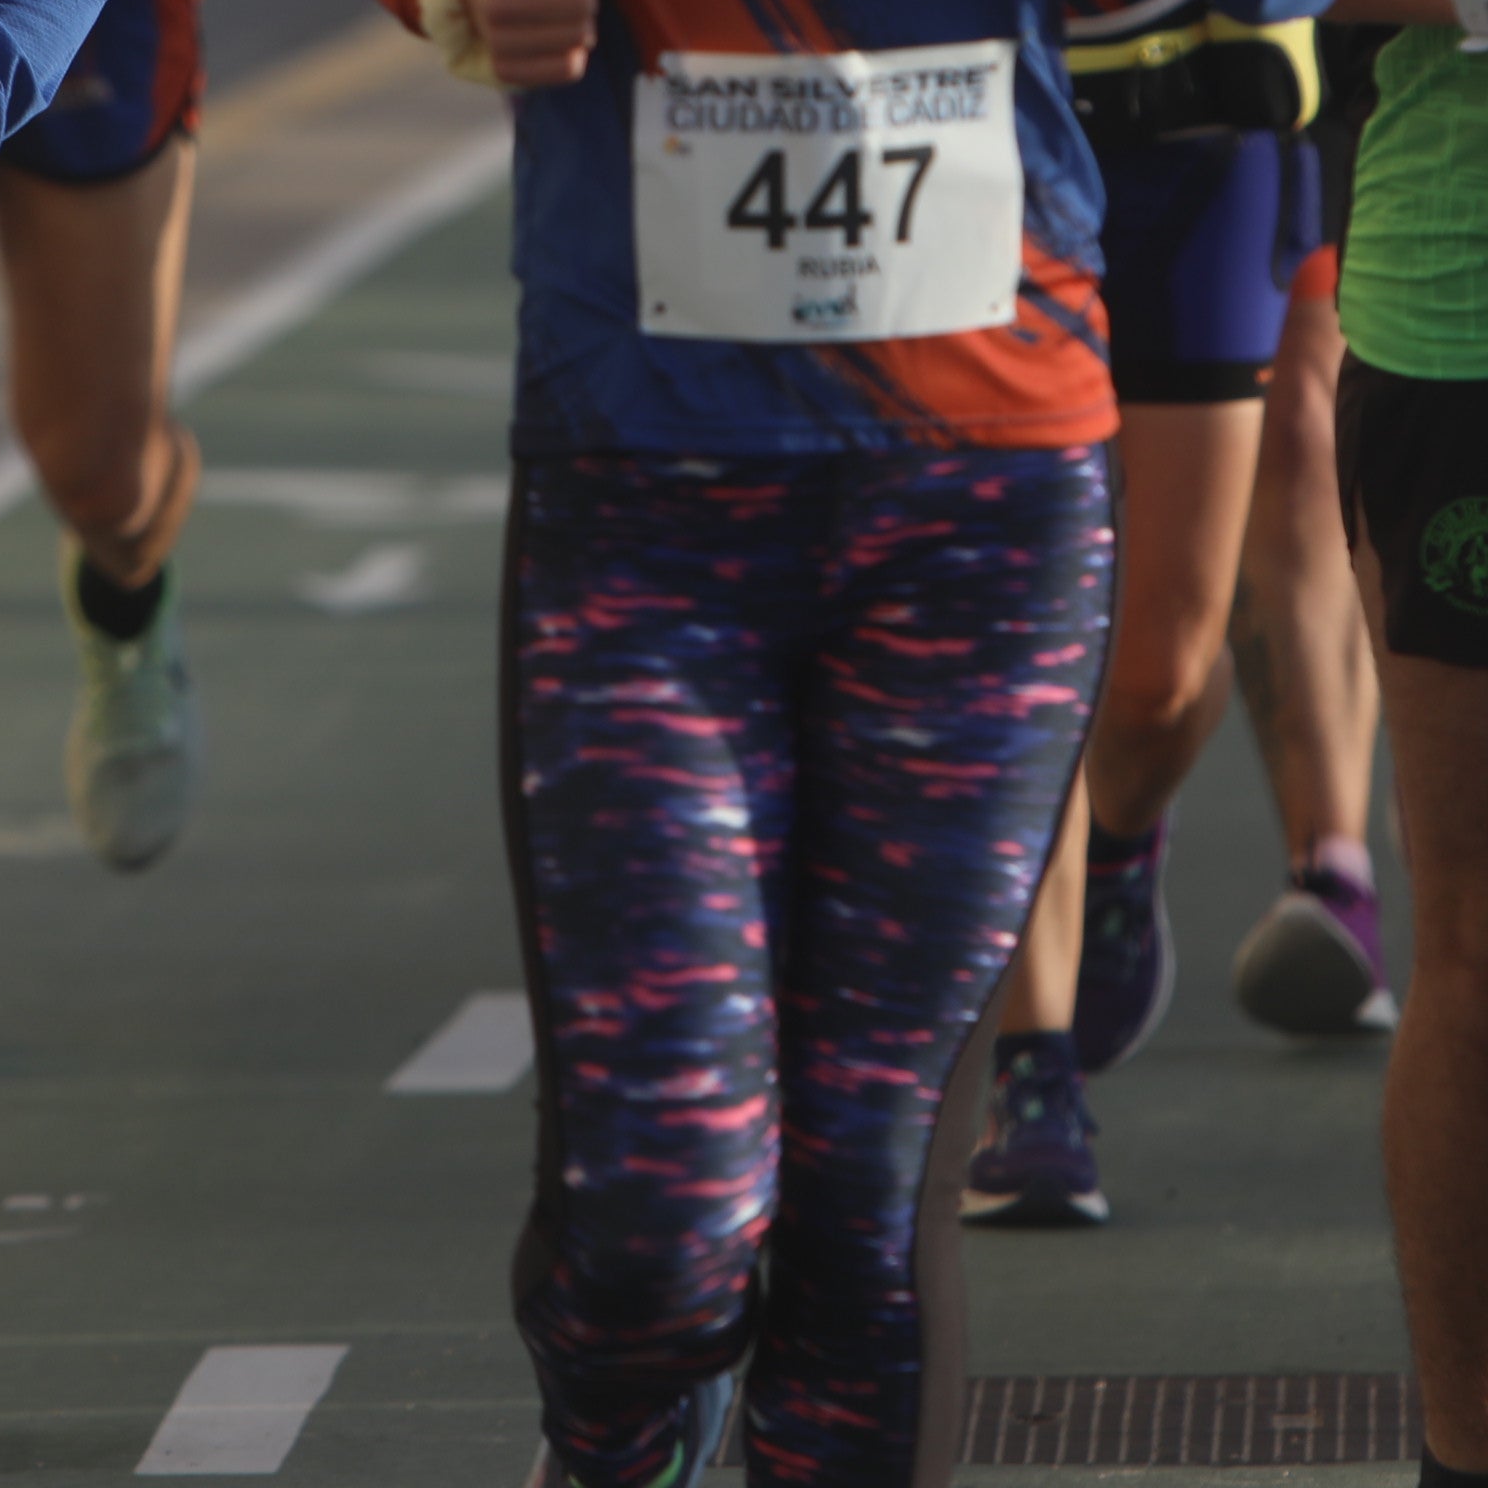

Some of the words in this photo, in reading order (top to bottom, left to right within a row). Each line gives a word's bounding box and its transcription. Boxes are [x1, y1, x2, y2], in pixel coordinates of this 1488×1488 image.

[666, 75, 760, 100] SAN
[667, 98, 821, 133] CIUDAD
[727, 146, 935, 250] 447
